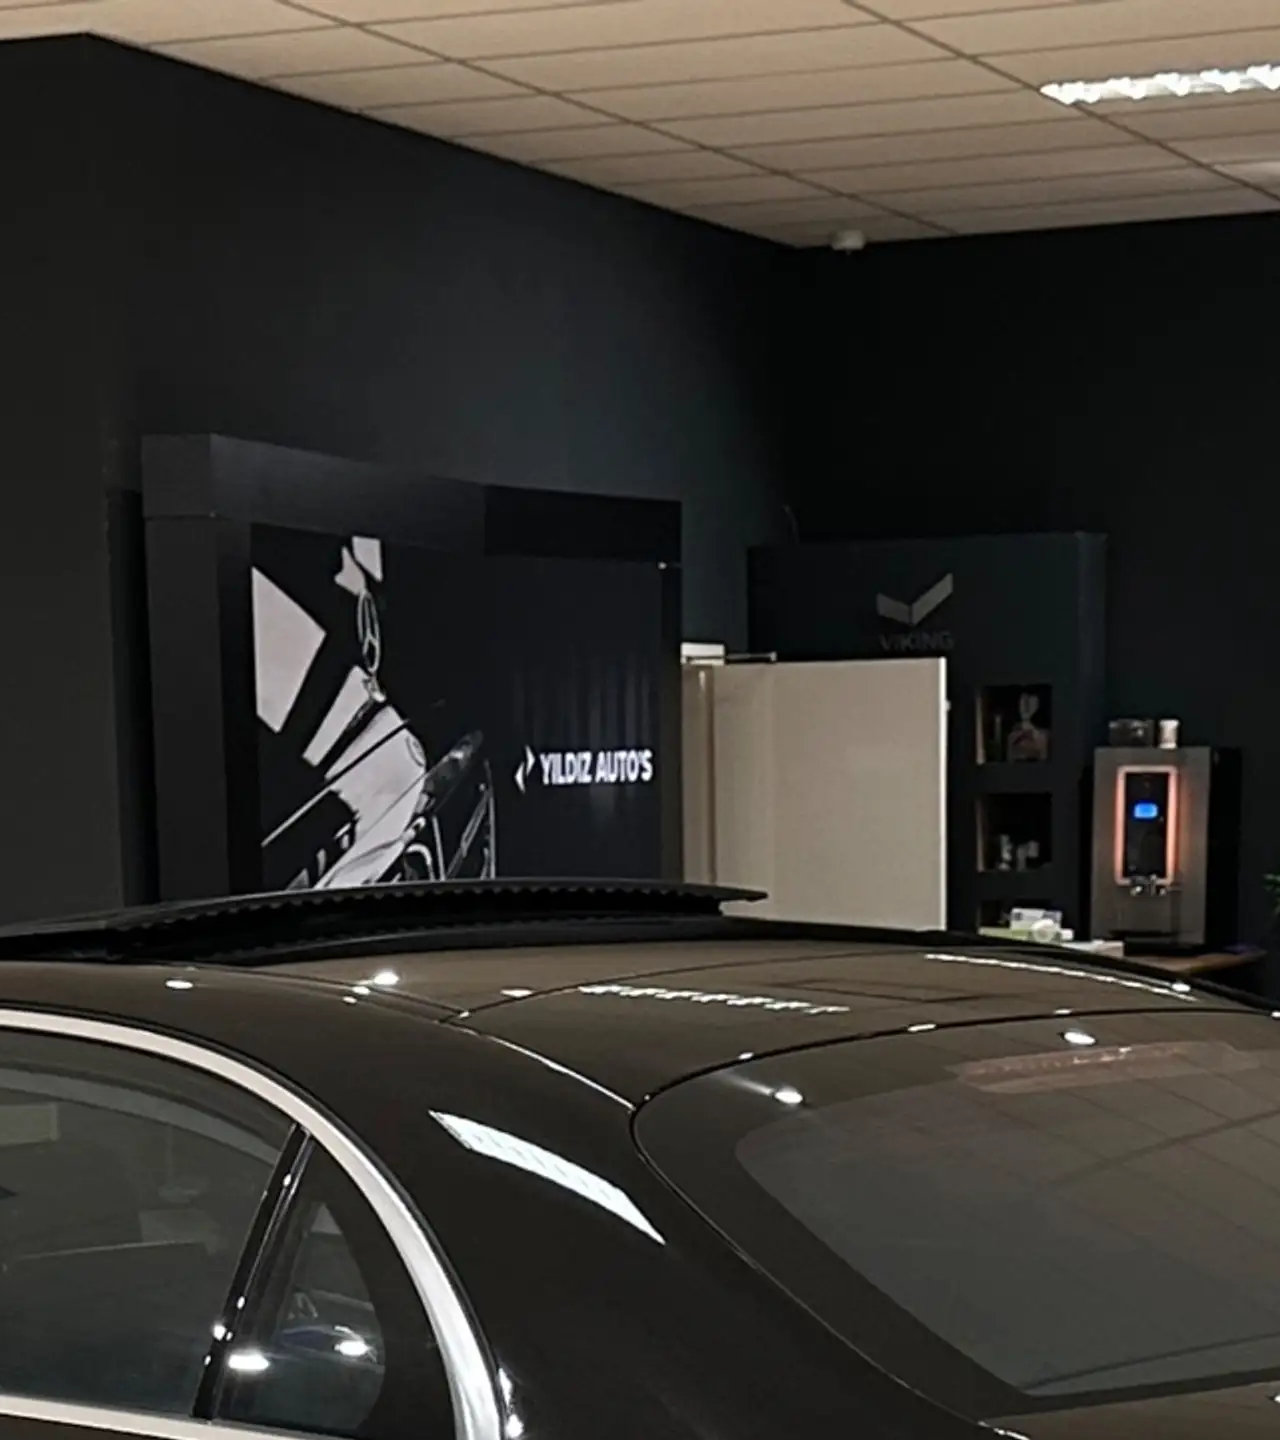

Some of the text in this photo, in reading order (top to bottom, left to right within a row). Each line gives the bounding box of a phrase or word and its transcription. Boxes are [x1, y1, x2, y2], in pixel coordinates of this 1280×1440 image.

[879, 630, 955, 651] VIKING
[540, 749, 653, 785] YILDIZ AUTO'S
